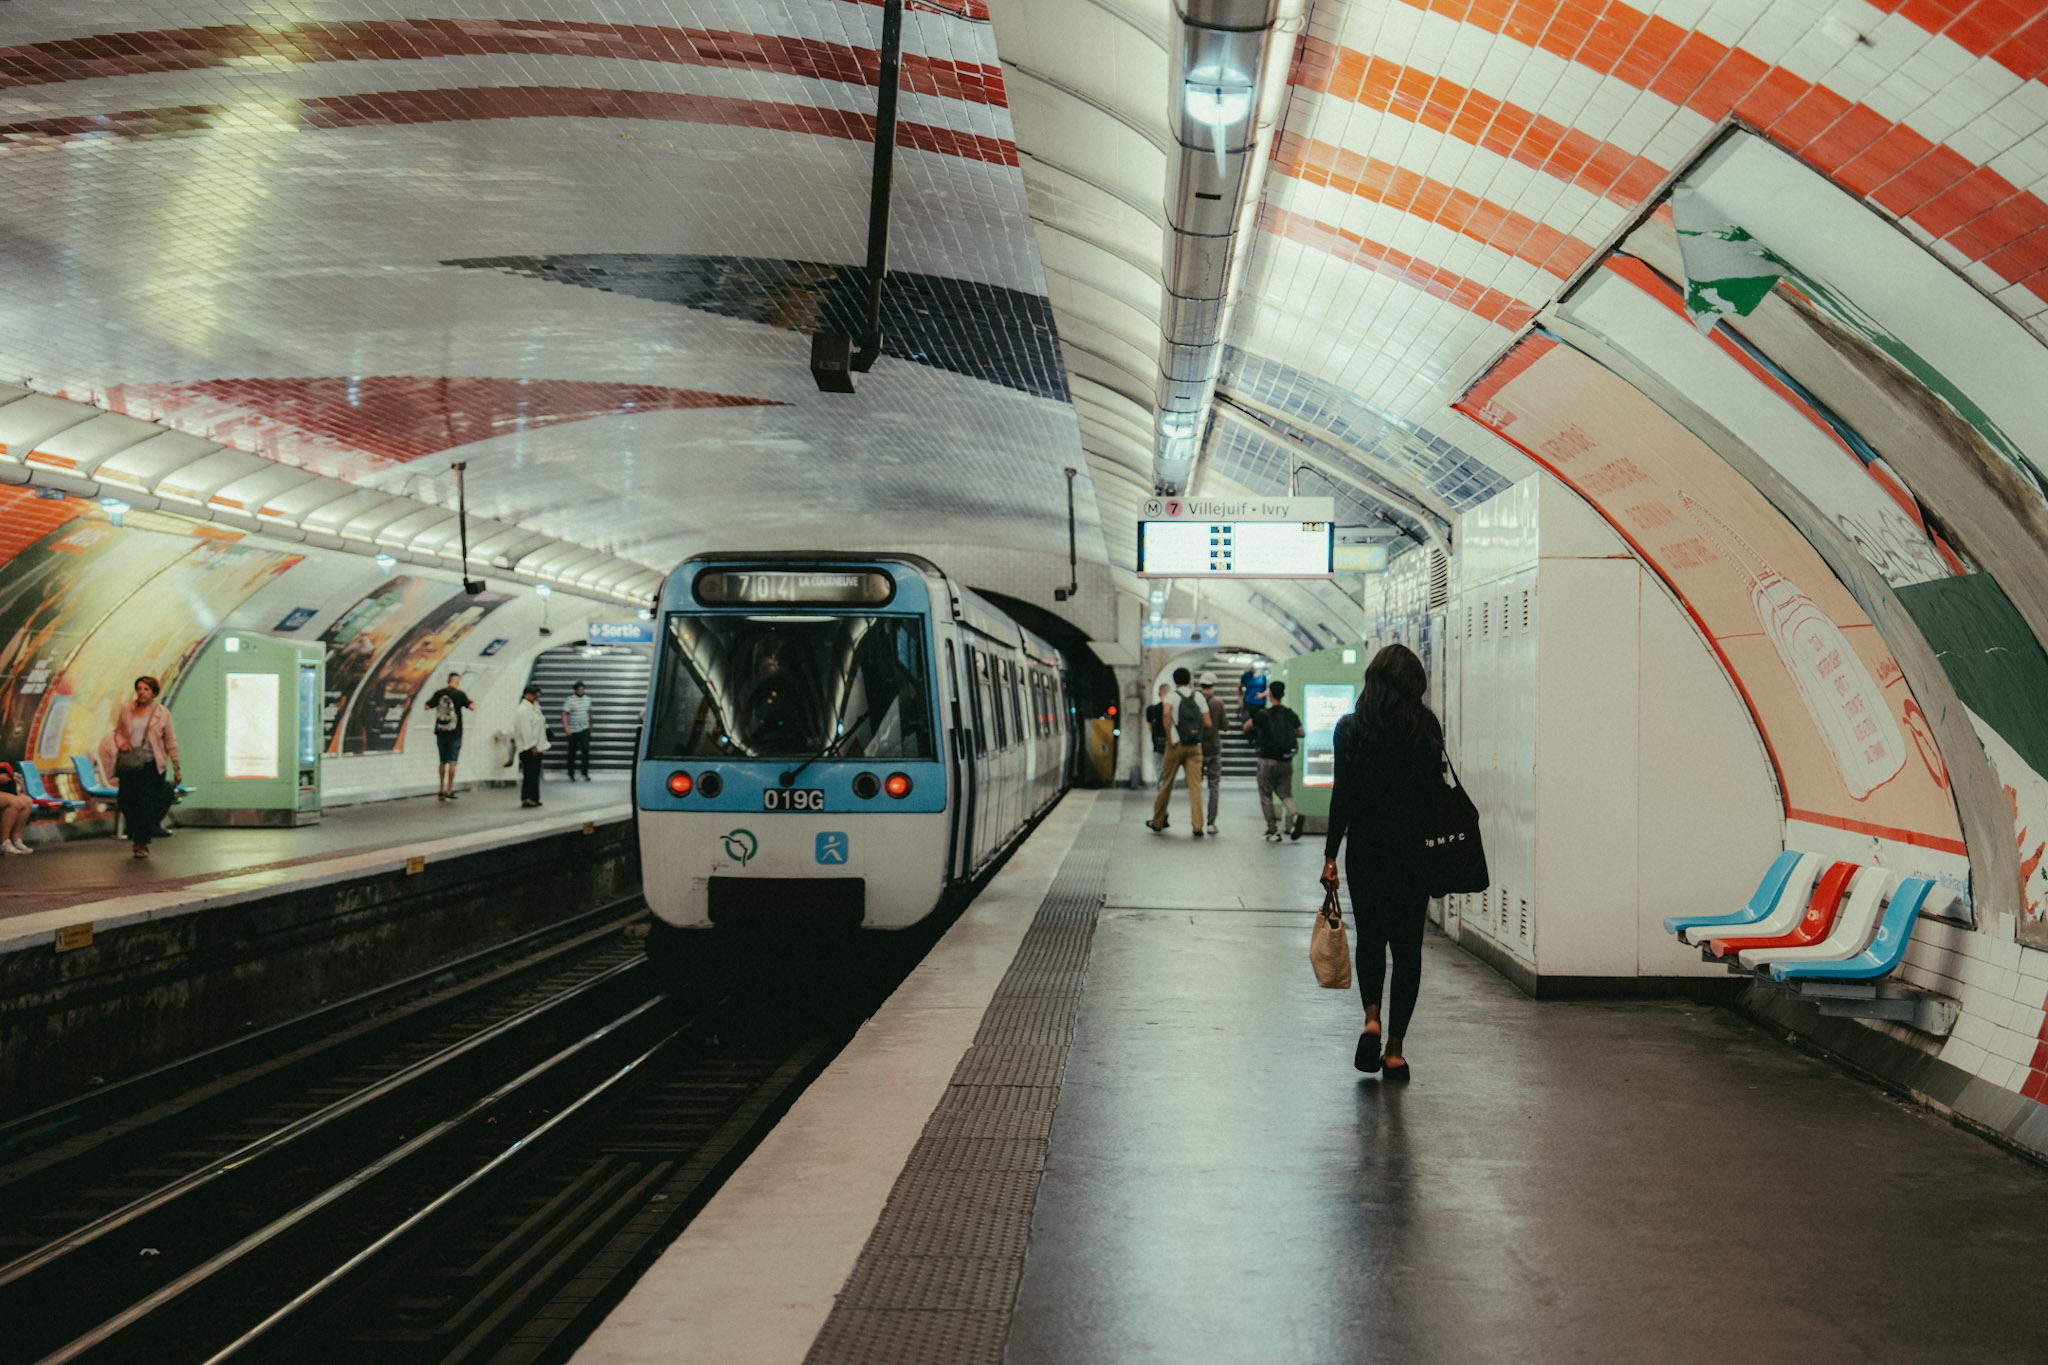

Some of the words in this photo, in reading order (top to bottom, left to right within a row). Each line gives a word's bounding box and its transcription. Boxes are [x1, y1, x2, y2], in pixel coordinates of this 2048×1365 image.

[1169, 503, 1179, 514] 7
[1188, 502, 1248, 518] Villejuif
[1262, 502, 1290, 518] Ivry
[799, 576, 810, 587] LA
[601, 623, 641, 638] Sortie
[1143, 625, 1183, 639] Sortie
[764, 789, 824, 810] 019G
